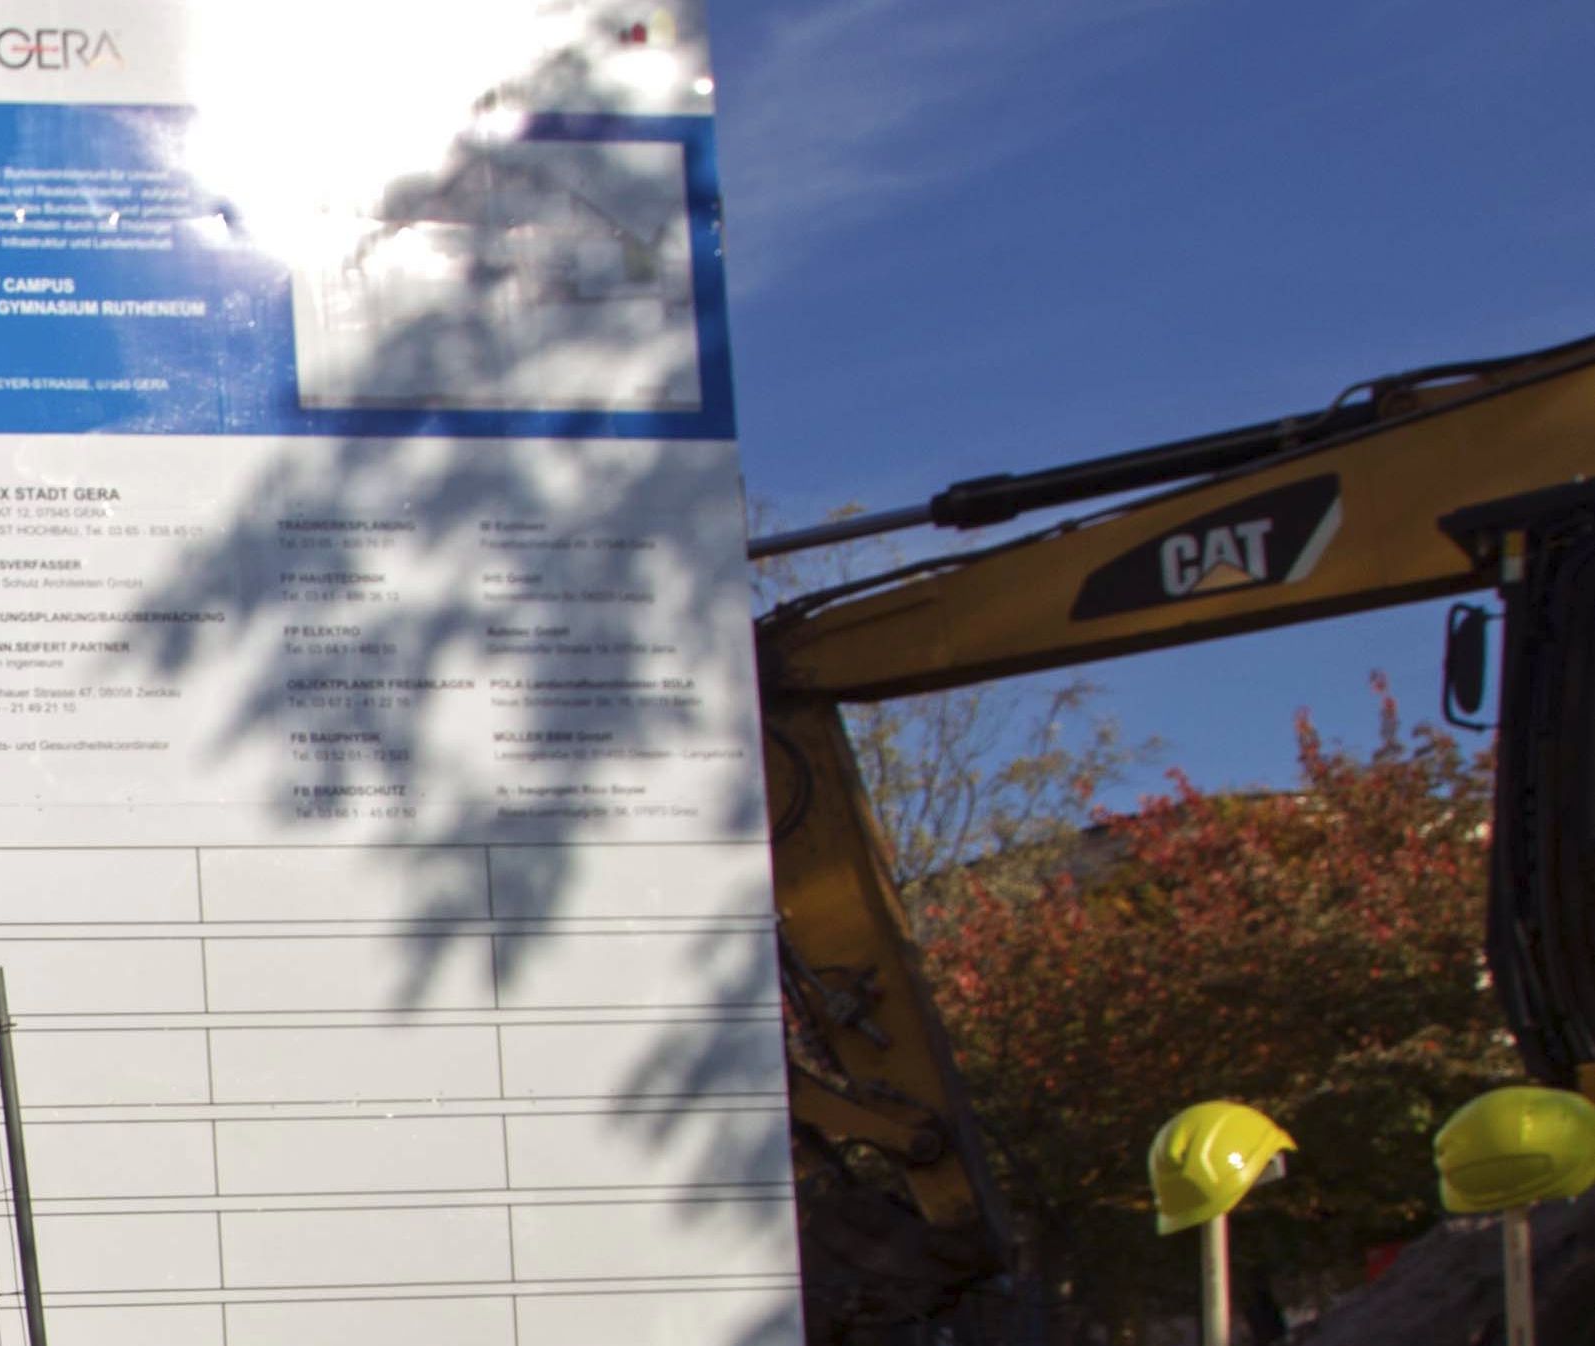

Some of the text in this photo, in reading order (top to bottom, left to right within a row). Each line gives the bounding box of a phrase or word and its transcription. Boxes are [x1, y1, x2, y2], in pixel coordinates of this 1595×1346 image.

[3, 277, 75, 294] CAMPUS
[102, 300, 205, 317] RUTHENEUM
[15, 488, 68, 500] STADT
[73, 488, 121, 500] GERA
[1159, 518, 1274, 597] CAT
[2, 578, 38, 588] Schulz
[16, 741, 36, 751] und
